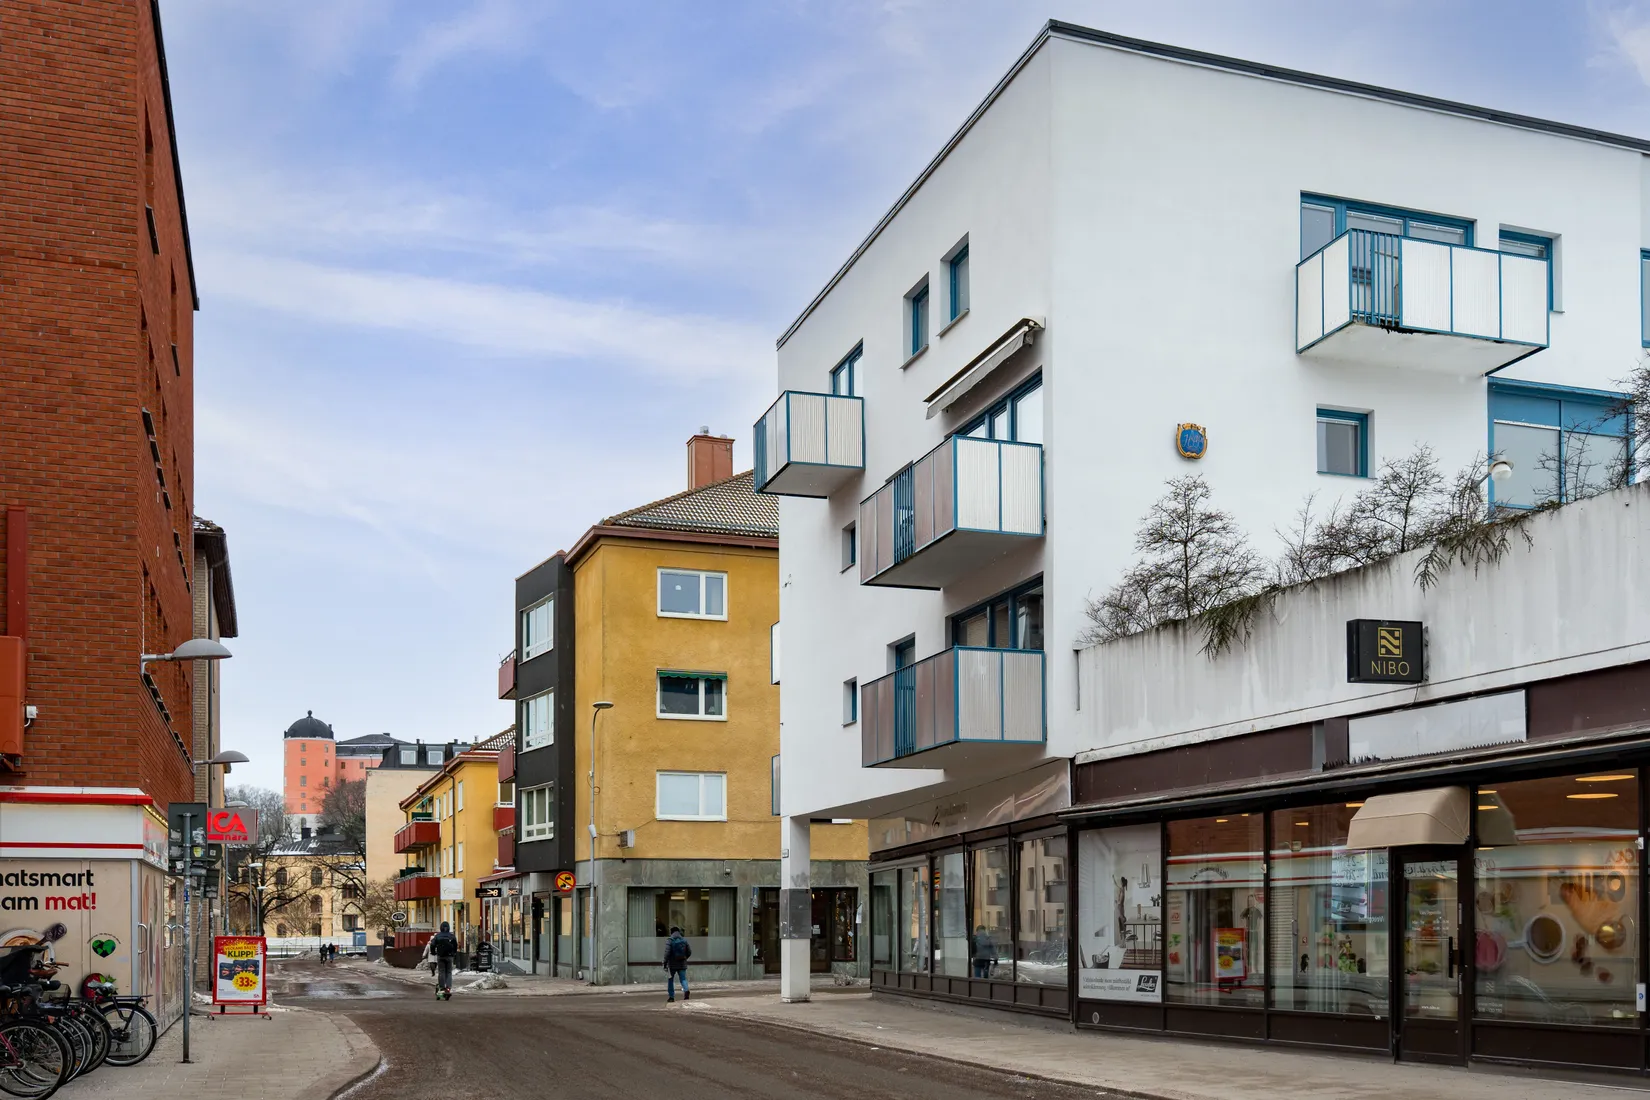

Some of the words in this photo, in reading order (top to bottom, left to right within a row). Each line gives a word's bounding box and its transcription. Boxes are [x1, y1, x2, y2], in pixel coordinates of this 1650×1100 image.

[1371, 660, 1410, 676] NIBO
[208, 811, 248, 833] ICA
[0, 896, 39, 911] am
[45, 892, 97, 911] mat!
[227, 950, 254, 958] KLIPP!
